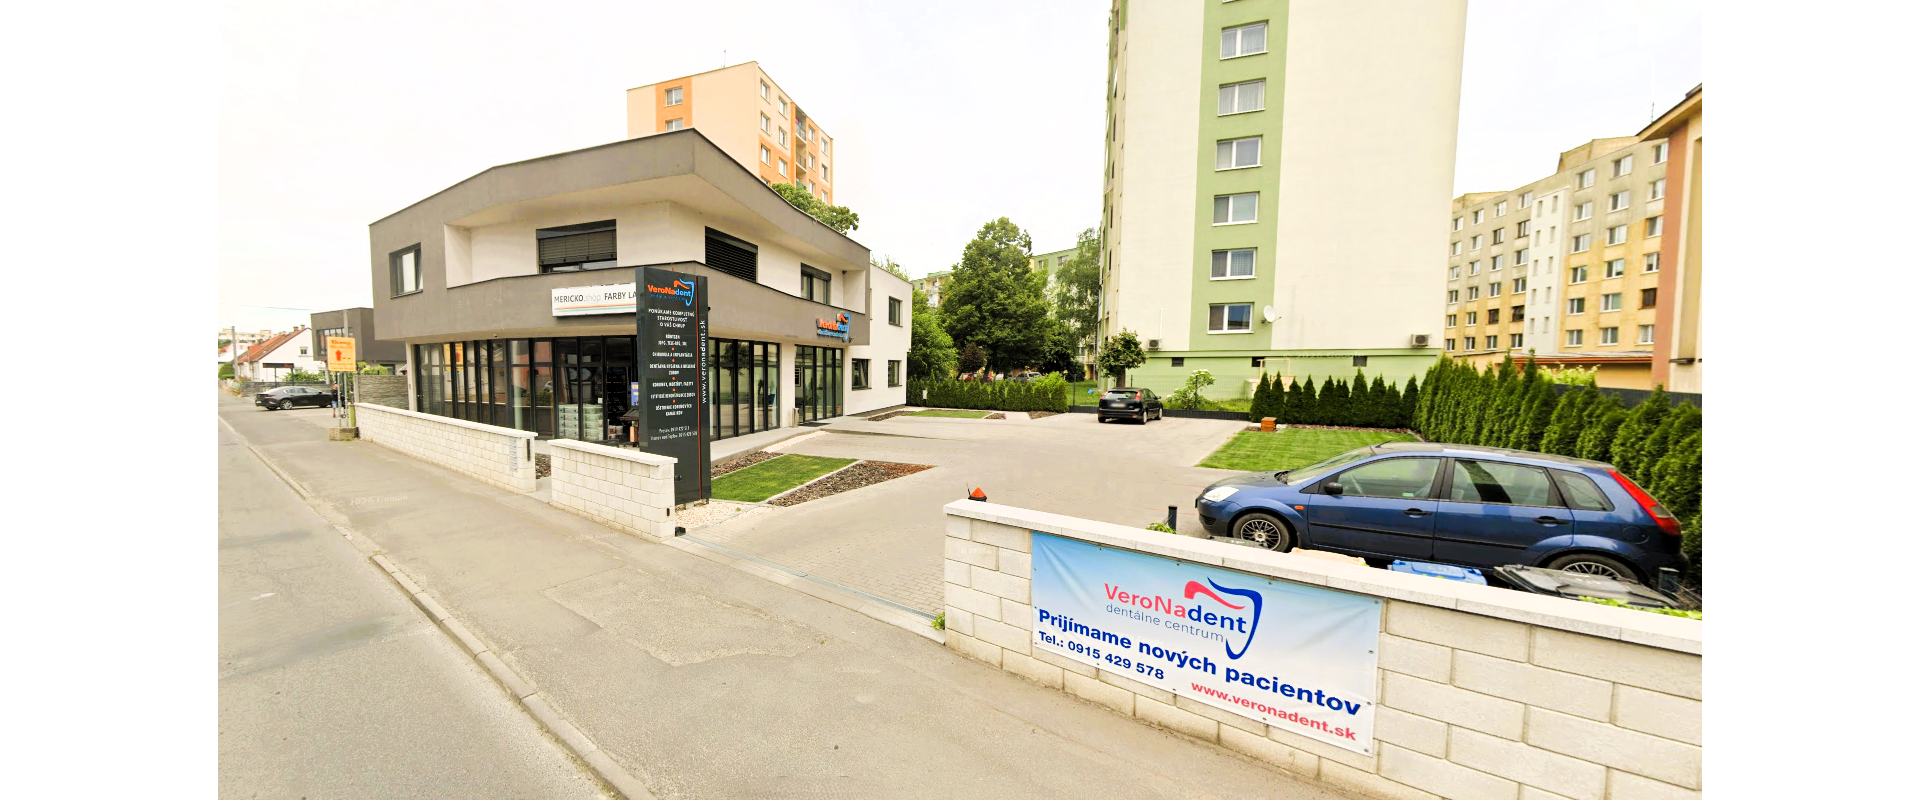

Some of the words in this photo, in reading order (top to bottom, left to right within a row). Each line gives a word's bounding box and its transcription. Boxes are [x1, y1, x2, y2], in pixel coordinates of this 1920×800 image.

[604, 291, 627, 301] FARBY
[647, 284, 691, 297] VeroNadent
[1104, 583, 1247, 634] VeroNadent
[1106, 603, 1161, 626] dentálne
[1164, 619, 1224, 643] centrum
[1038, 630, 1064, 648] Tel.:
[1068, 640, 1101, 660] 0915
[1104, 653, 1132, 669] 429
[1136, 662, 1165, 680] 578
[1039, 608, 1132, 649] Prijímame
[1138, 641, 1217, 675] nových
[1225, 666, 1362, 716] pacientov
[1191, 682, 1357, 741] www.veronadent.sk
